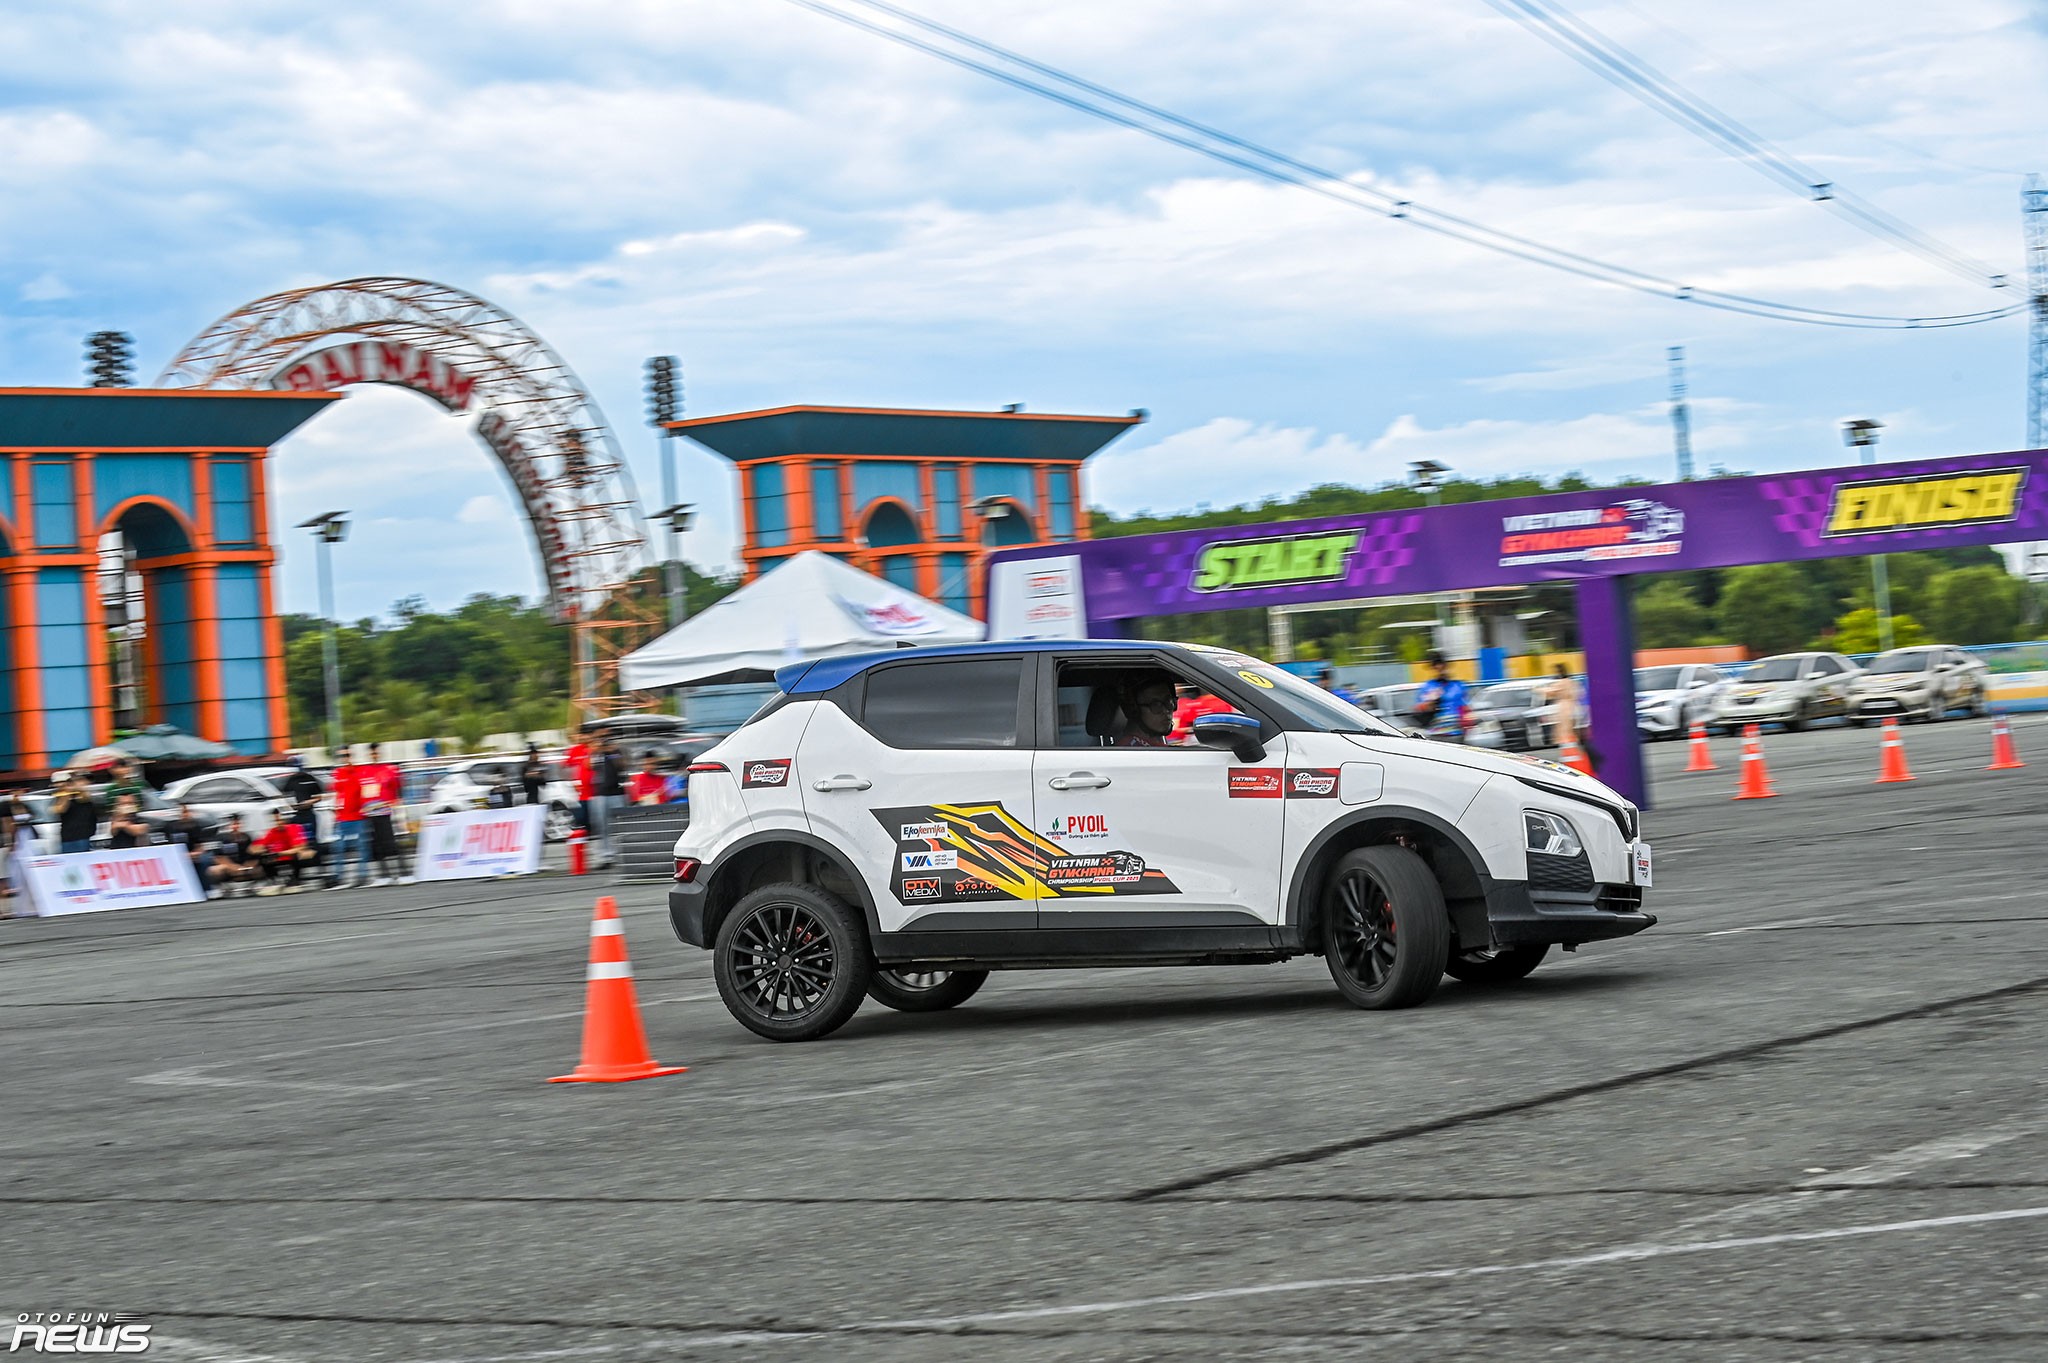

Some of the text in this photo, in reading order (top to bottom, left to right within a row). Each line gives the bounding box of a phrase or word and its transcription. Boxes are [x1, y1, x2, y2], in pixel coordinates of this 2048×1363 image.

[1828, 472, 2024, 532] FINISH
[1193, 534, 1360, 588] START
[1067, 815, 1109, 833] PVOIL
[903, 825, 946, 838] Ekokemika
[1051, 858, 1100, 868] VIETNAM
[1048, 867, 1116, 879] GYMKHANA
[1047, 877, 1094, 885] CHAMPIONSHIP
[905, 888, 940, 897] MEDIA
